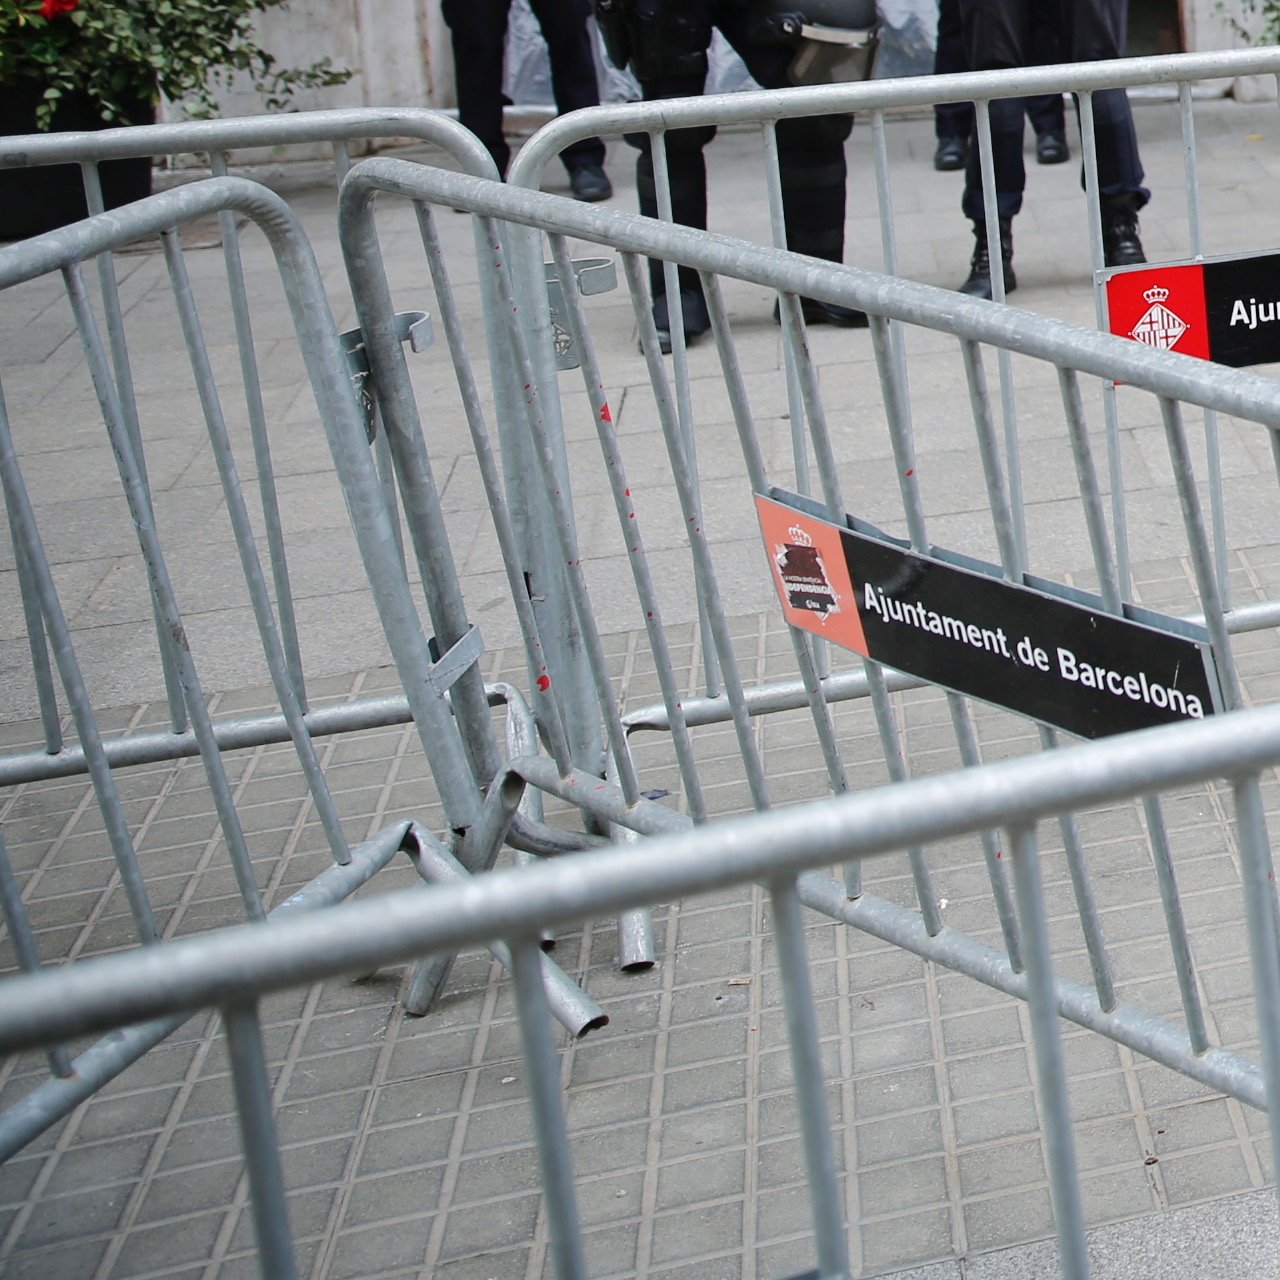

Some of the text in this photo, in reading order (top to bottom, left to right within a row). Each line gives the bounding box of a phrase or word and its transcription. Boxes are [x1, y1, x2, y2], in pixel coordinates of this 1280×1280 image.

[863, 581, 1204, 721] Ajuntament de Barcelona
